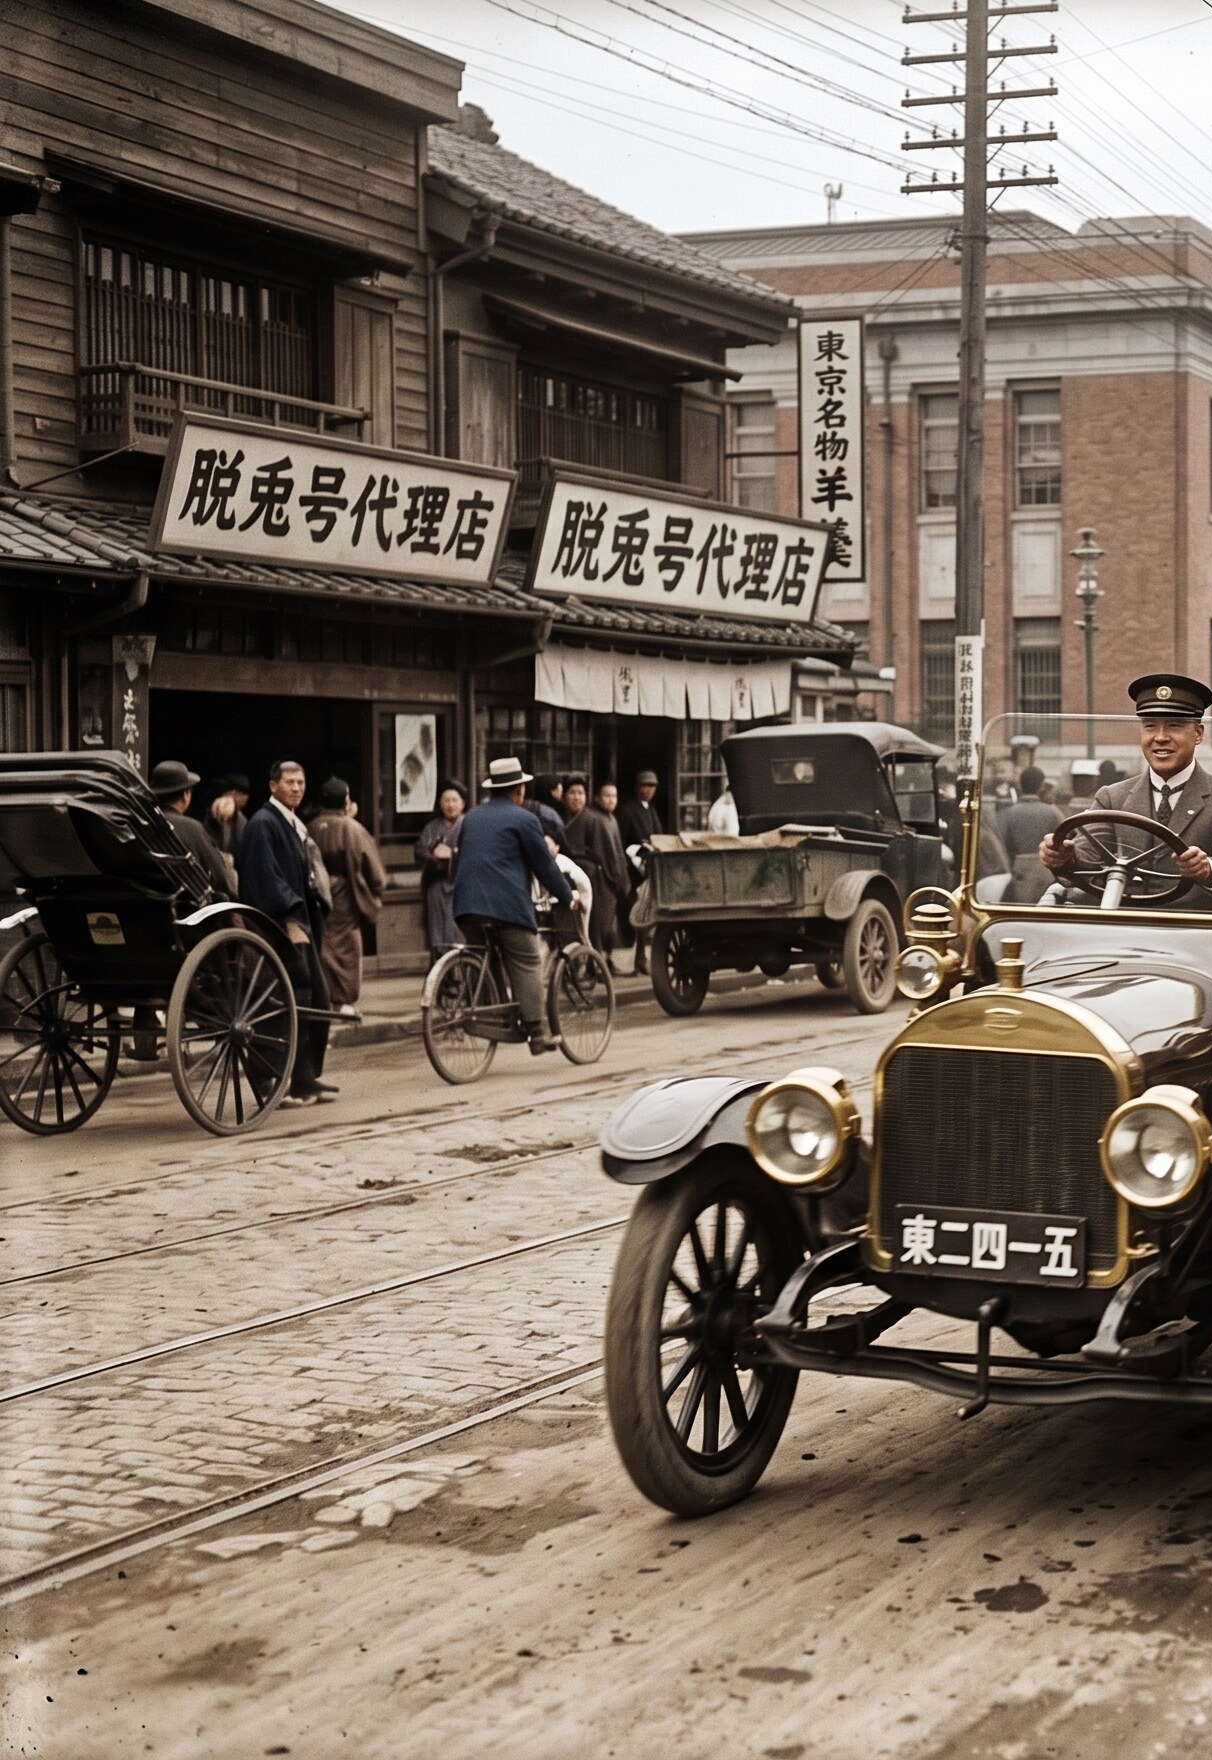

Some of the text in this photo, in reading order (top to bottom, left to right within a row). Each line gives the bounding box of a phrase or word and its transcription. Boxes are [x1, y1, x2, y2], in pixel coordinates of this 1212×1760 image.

[899, 1213, 1079, 1278] 東二四一五
